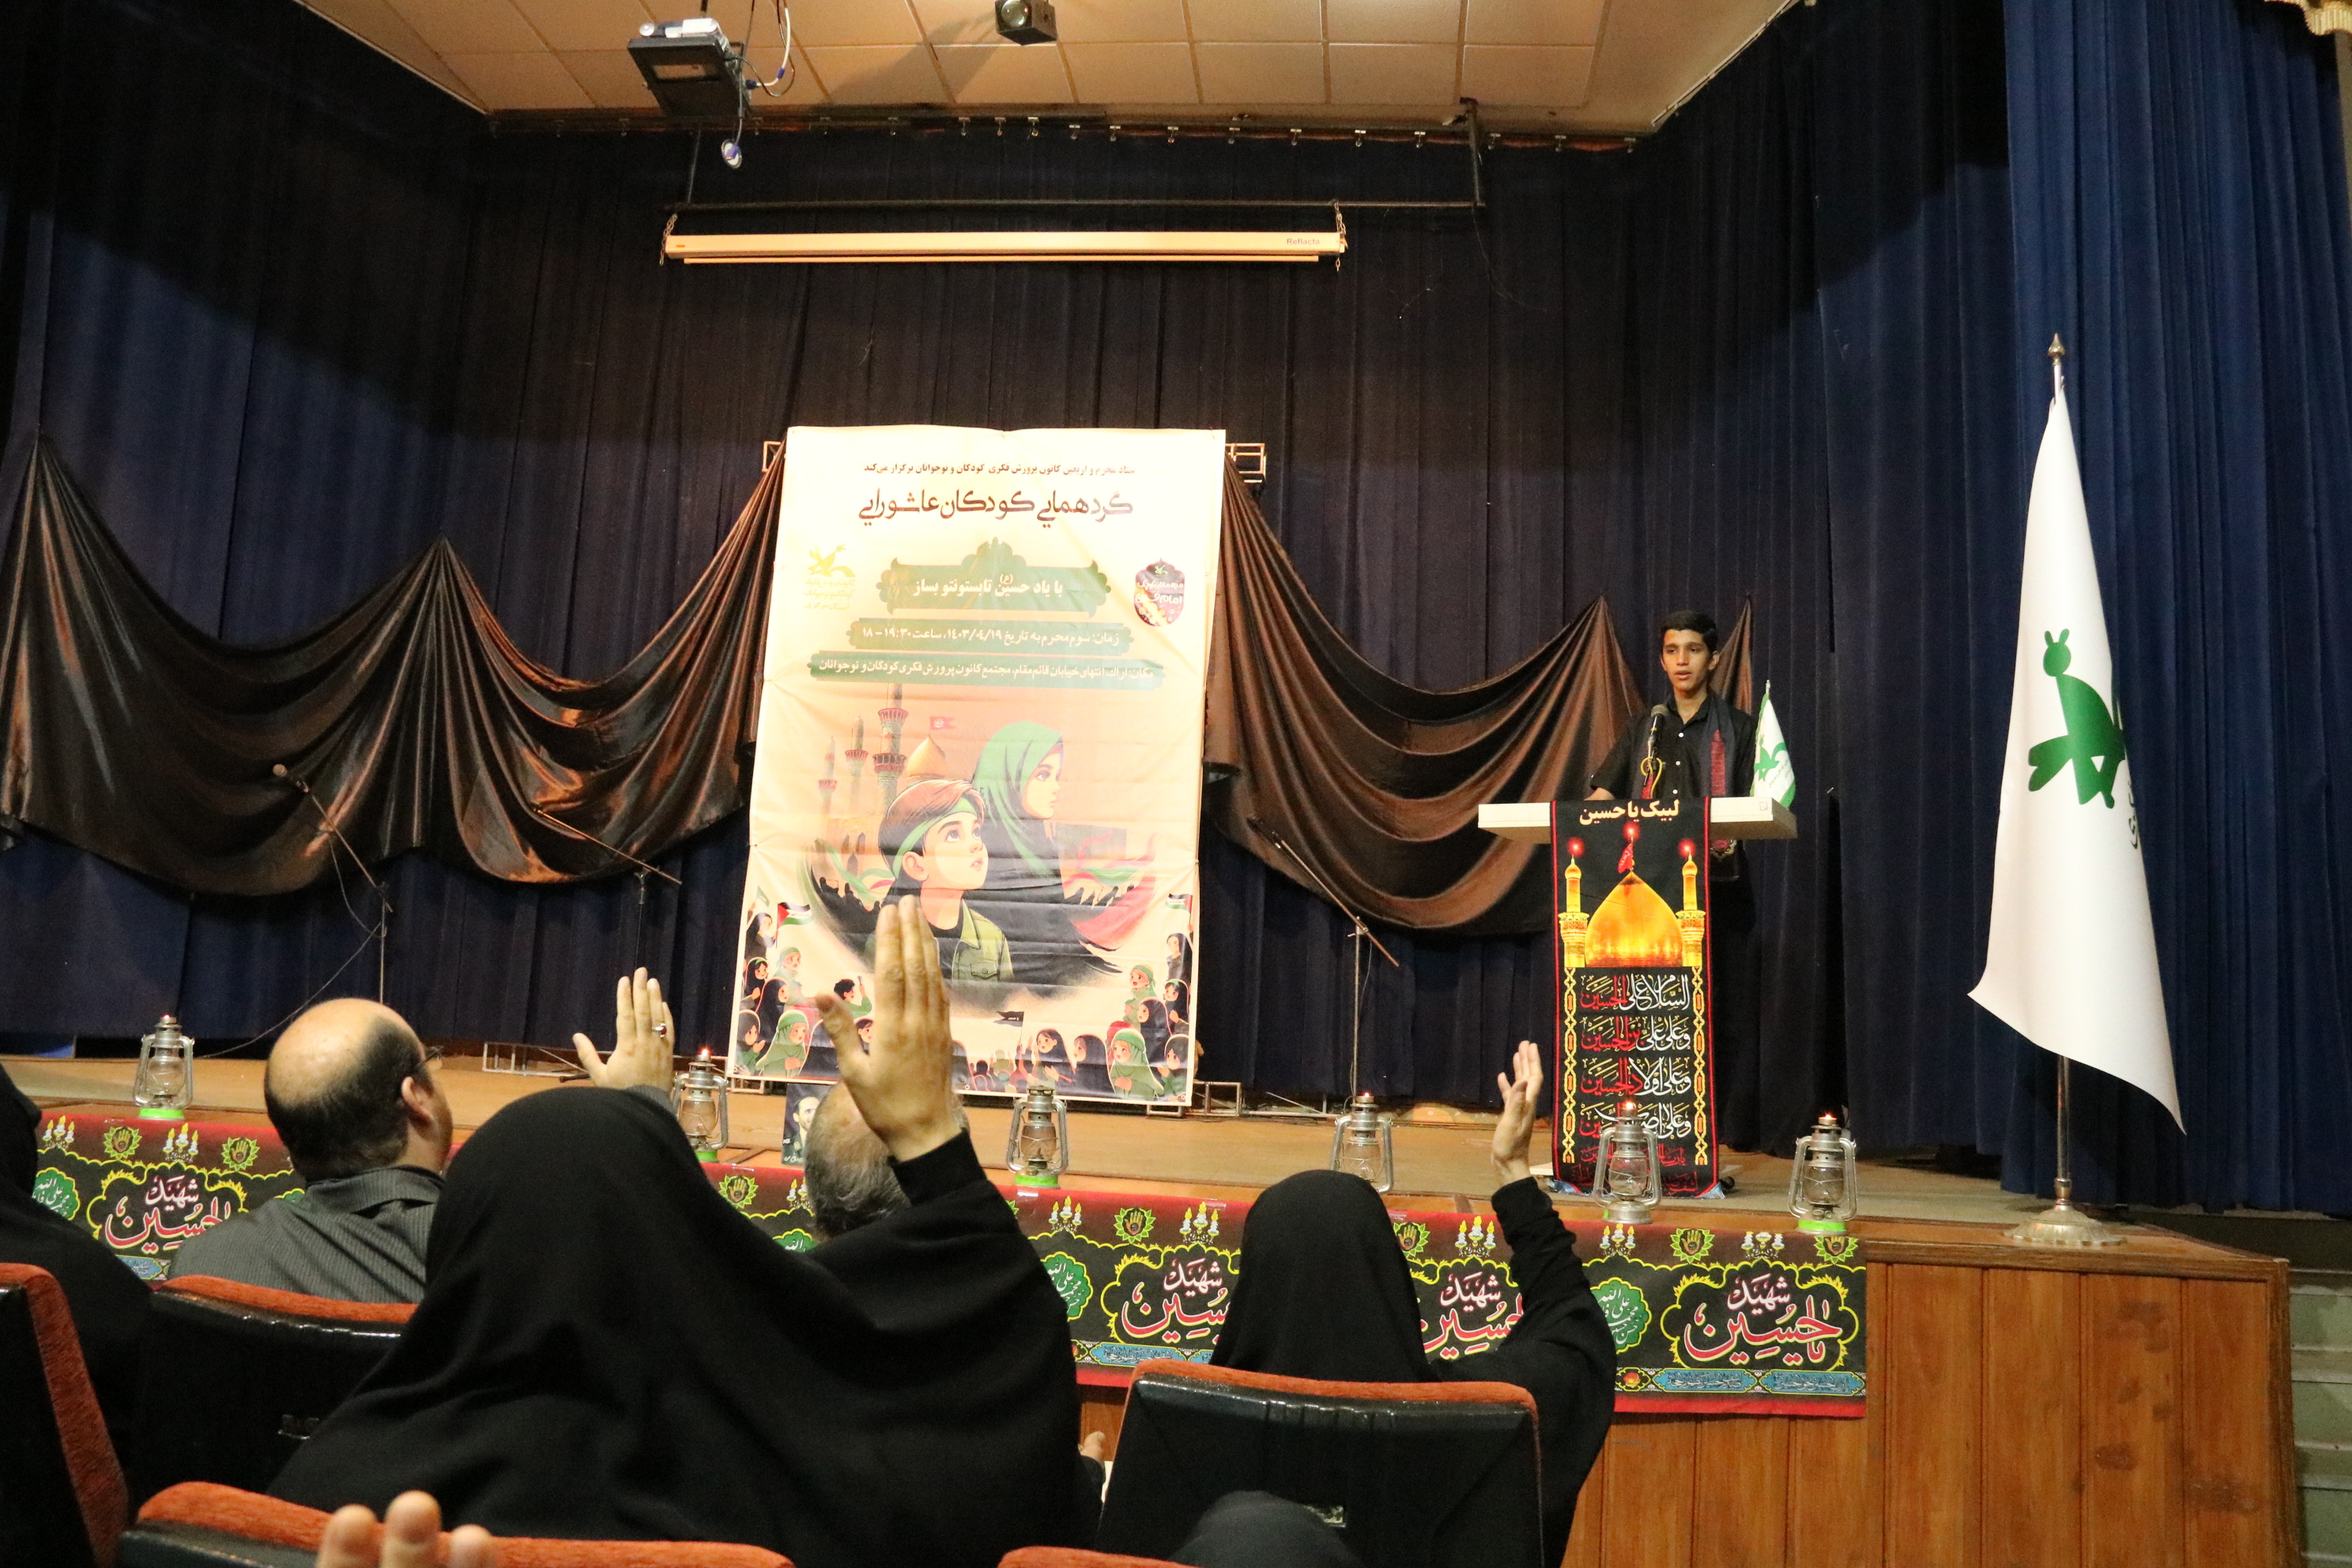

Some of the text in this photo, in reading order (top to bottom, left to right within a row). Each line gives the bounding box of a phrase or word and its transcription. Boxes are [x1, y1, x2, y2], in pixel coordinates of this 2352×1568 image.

[891, 463, 914, 474] برگزار
[915, 462, 948, 474] نوجوانان
[956, 463, 985, 474] کودکان
[988, 462, 1010, 474] فکری
[1011, 463, 1038, 475] پرورش
[1038, 464, 1061, 475] کانون
[1089, 467, 1094, 476] و
[858, 487, 940, 527] عاشورایی
[940, 490, 1035, 520] کودکان
[912, 578, 939, 597] بساز
[941, 578, 993, 597] تابستونتو
[994, 582, 1030, 597] حسین
[1033, 579, 1050, 597] یاد
[1054, 579, 1064, 598] با
[912, 628, 941, 639] ساعت
[1004, 630, 1029, 646] تاریخ
[1030, 631, 1041, 643] به
[1041, 633, 1069, 646] محرم
[1069, 635, 1091, 647] سوم
[1092, 631, 1120, 646] زمان:
[819, 658, 859, 673] نوجوانان
[861, 663, 867, 673] و
[867, 660, 899, 675] کودکان
[899, 661, 923, 674] فکری
[922, 662, 956, 677] پرورش
[956, 663, 982, 677] کانون
[982, 664, 1011, 679] مجتمع
[1050, 665, 1080, 678] خیابان
[1080, 665, 1105, 680] انتهای
[1579, 799, 1680, 826] لبیک یا حسین
[1608, 1306, 1639, 1327] محم
